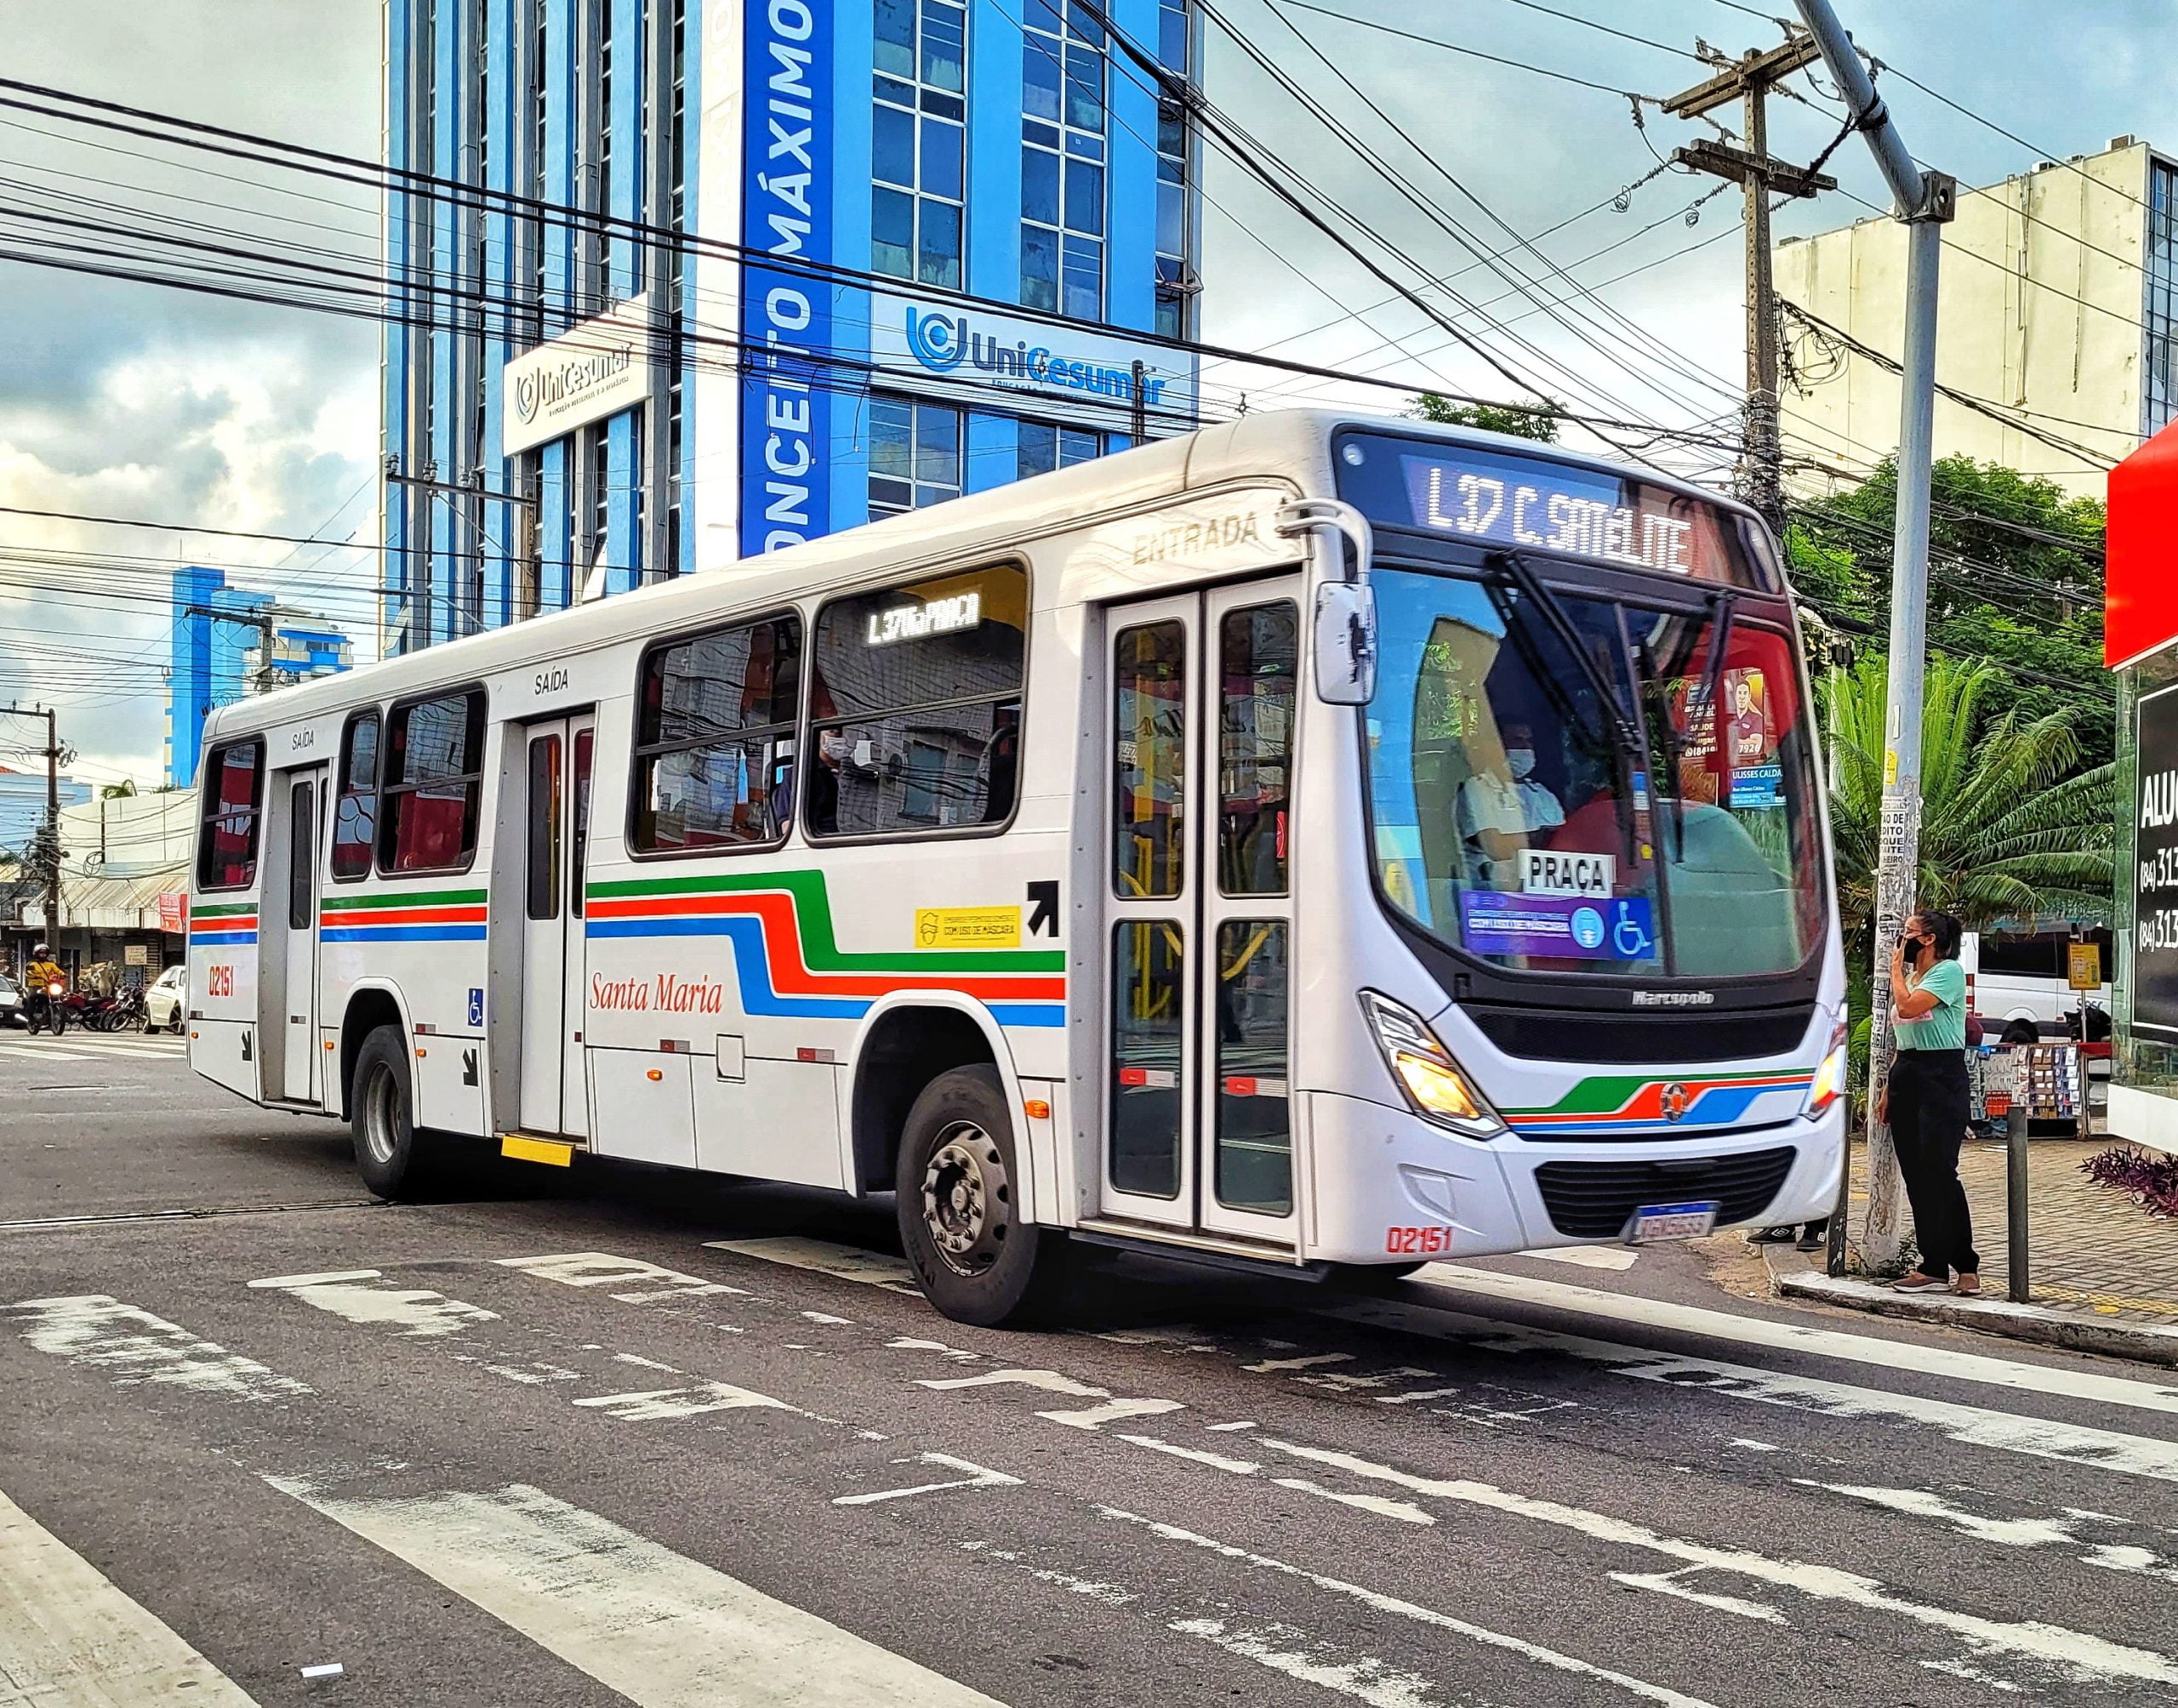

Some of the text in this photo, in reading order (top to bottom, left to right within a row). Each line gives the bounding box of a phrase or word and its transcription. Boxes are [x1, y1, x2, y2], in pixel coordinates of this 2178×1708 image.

[757, 0, 812, 554] ONCEITO MÁXIMO
[1428, 468, 1504, 533] L37
[1132, 515, 1258, 566] ENTRADA
[534, 664, 568, 696] SAÍDA
[292, 726, 314, 751] SAÍDA
[1732, 768, 1783, 779] ULISSES CALDA
[2141, 769, 2178, 828] ALU
[1530, 856, 1607, 893] PRAÇA
[209, 965, 234, 997] 02151
[589, 971, 723, 1014] Santa Maria
[1387, 1226, 1452, 1254] 02151
